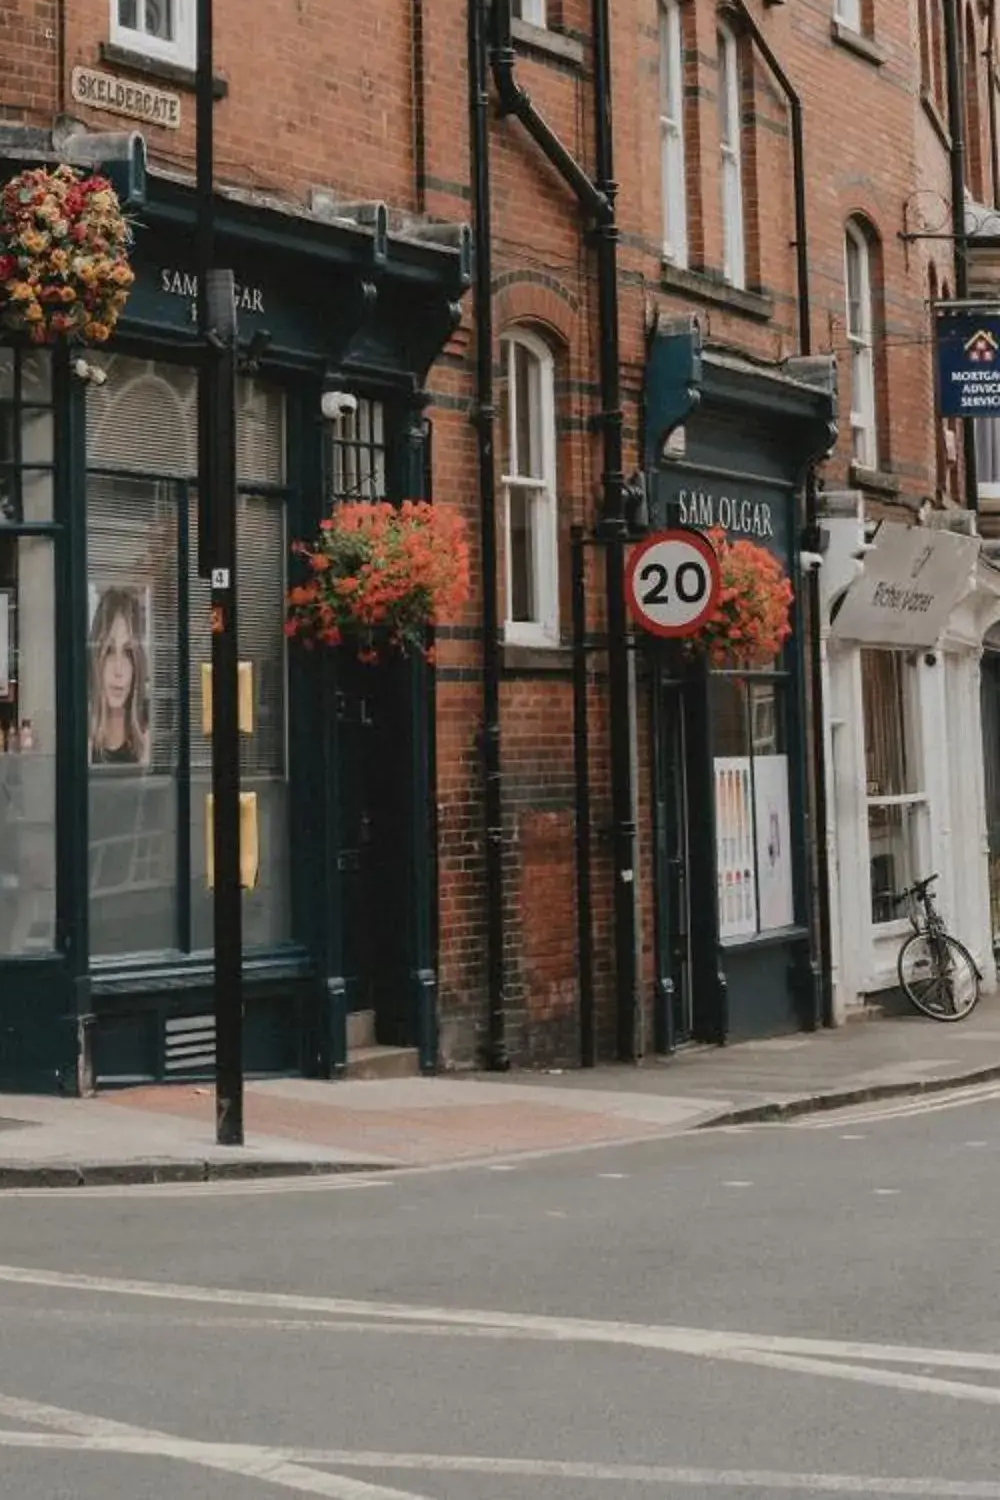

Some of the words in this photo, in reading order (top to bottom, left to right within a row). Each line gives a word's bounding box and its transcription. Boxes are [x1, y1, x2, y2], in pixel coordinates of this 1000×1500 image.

[78, 74, 178, 121] SKELDERGATE
[161, 269, 198, 298] SAM
[679, 490, 713, 526] SAM
[719, 496, 774, 537] OLGAR
[640, 562, 706, 604] 20
